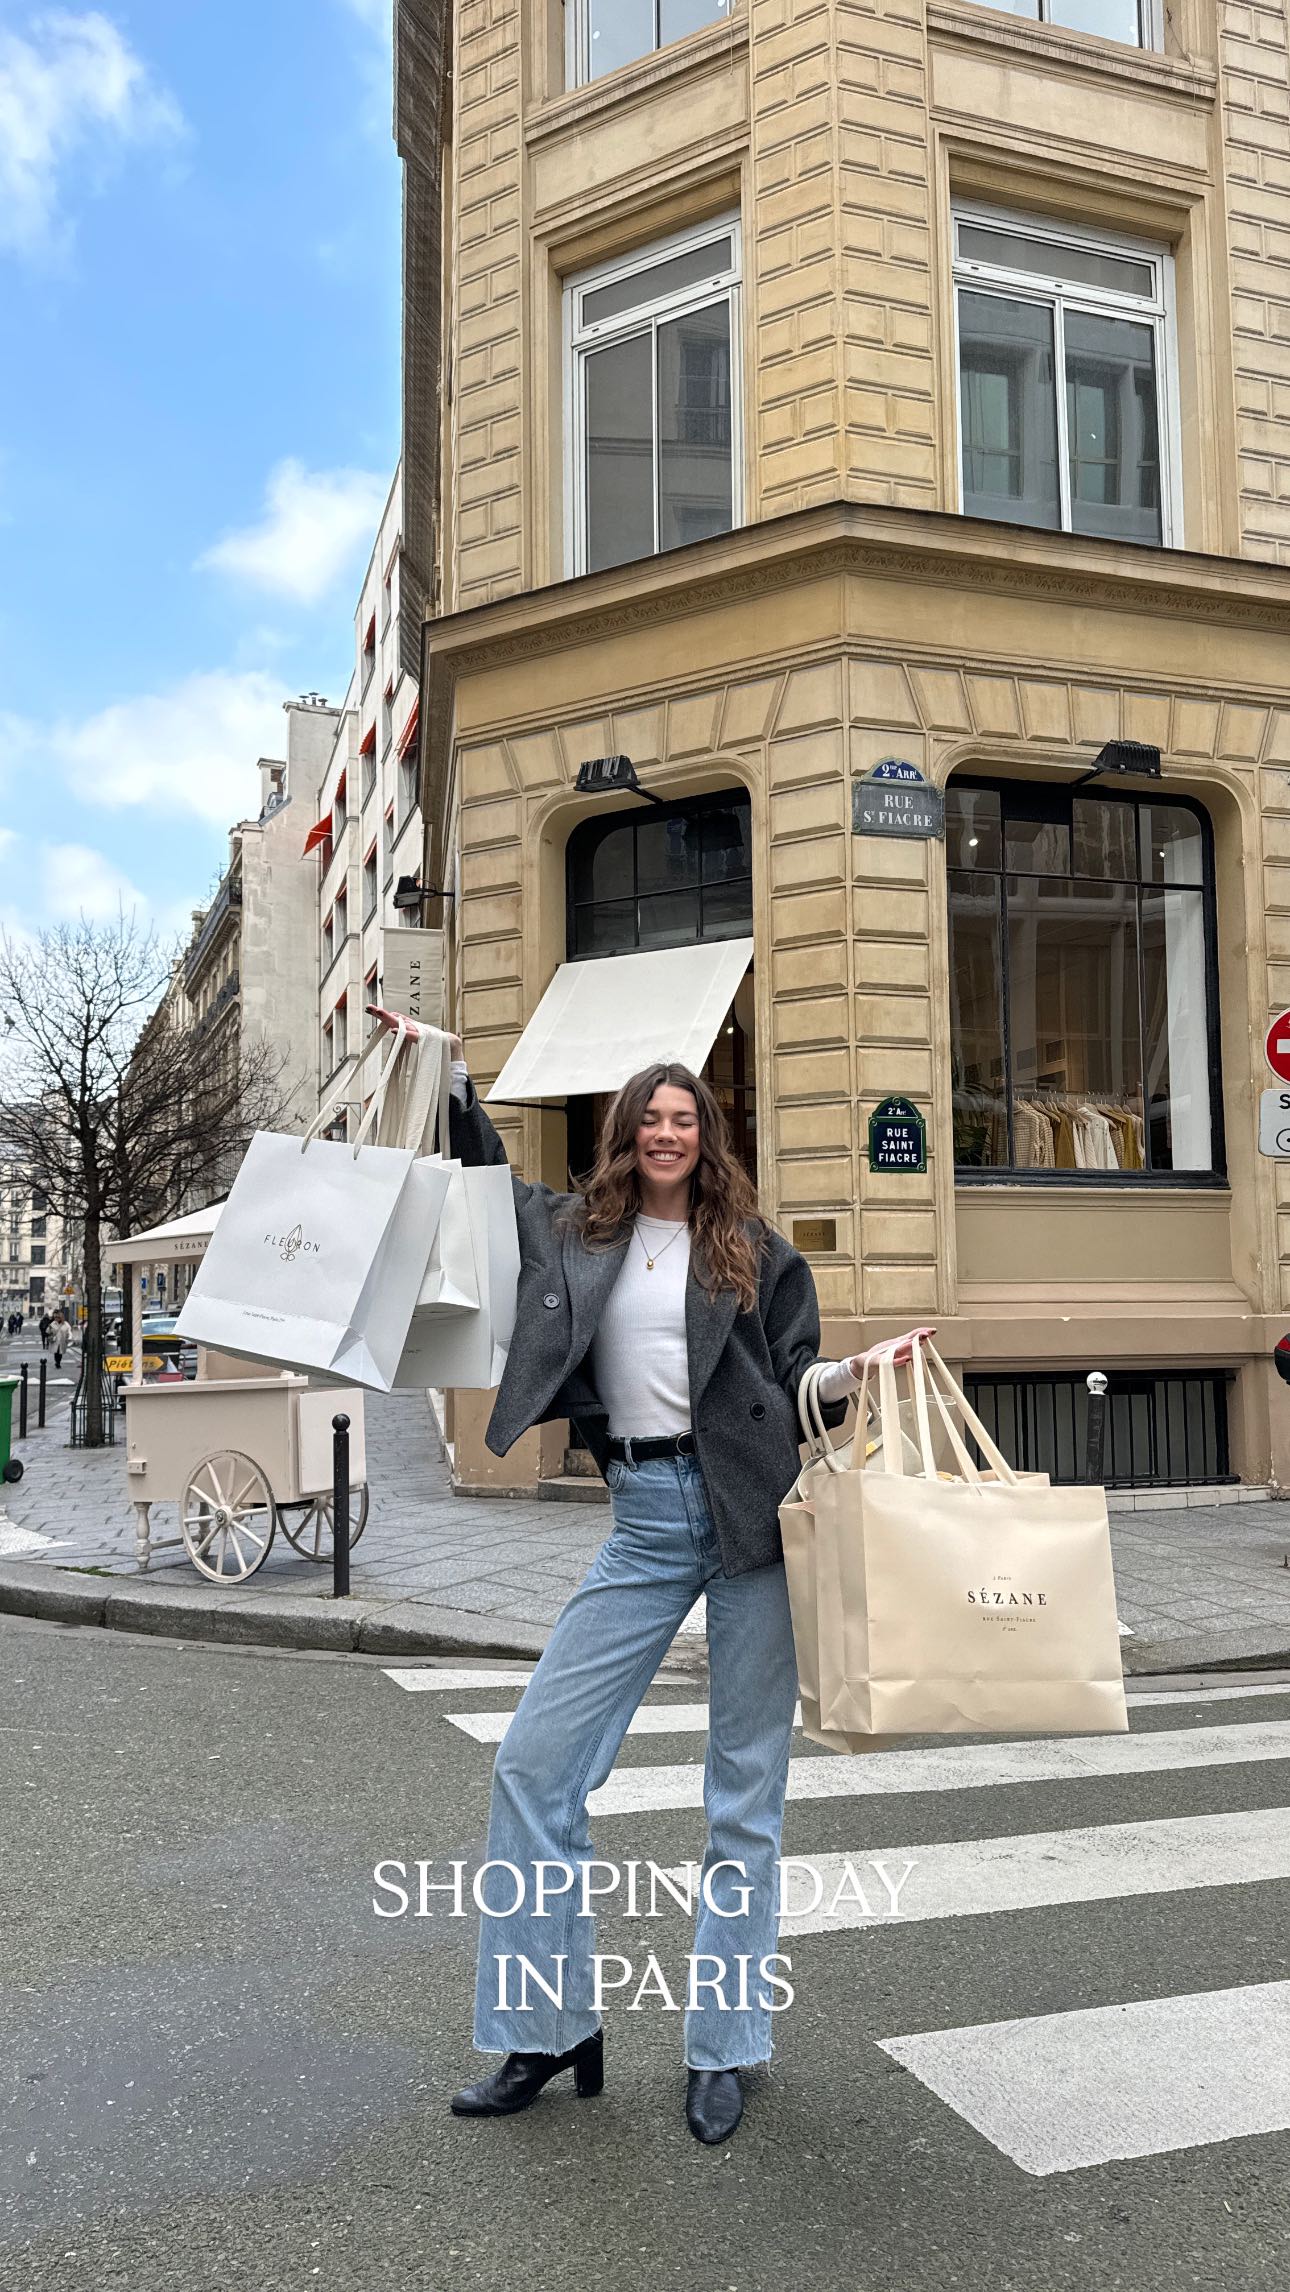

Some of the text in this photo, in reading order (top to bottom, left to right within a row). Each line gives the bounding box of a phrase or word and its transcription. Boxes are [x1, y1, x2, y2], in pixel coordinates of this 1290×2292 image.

[884, 794, 914, 808] RUE
[878, 811, 933, 827] FIACRE
[409, 960, 421, 1016] ZANE
[886, 1128, 909, 1138] RUE
[881, 1140, 914, 1150] SAINT
[878, 1153, 918, 1163] FIACRE
[263, 1234, 321, 1252] FLEURON
[108, 1359, 155, 1369] Piétns
[967, 1587, 1047, 1606] SÉZANE
